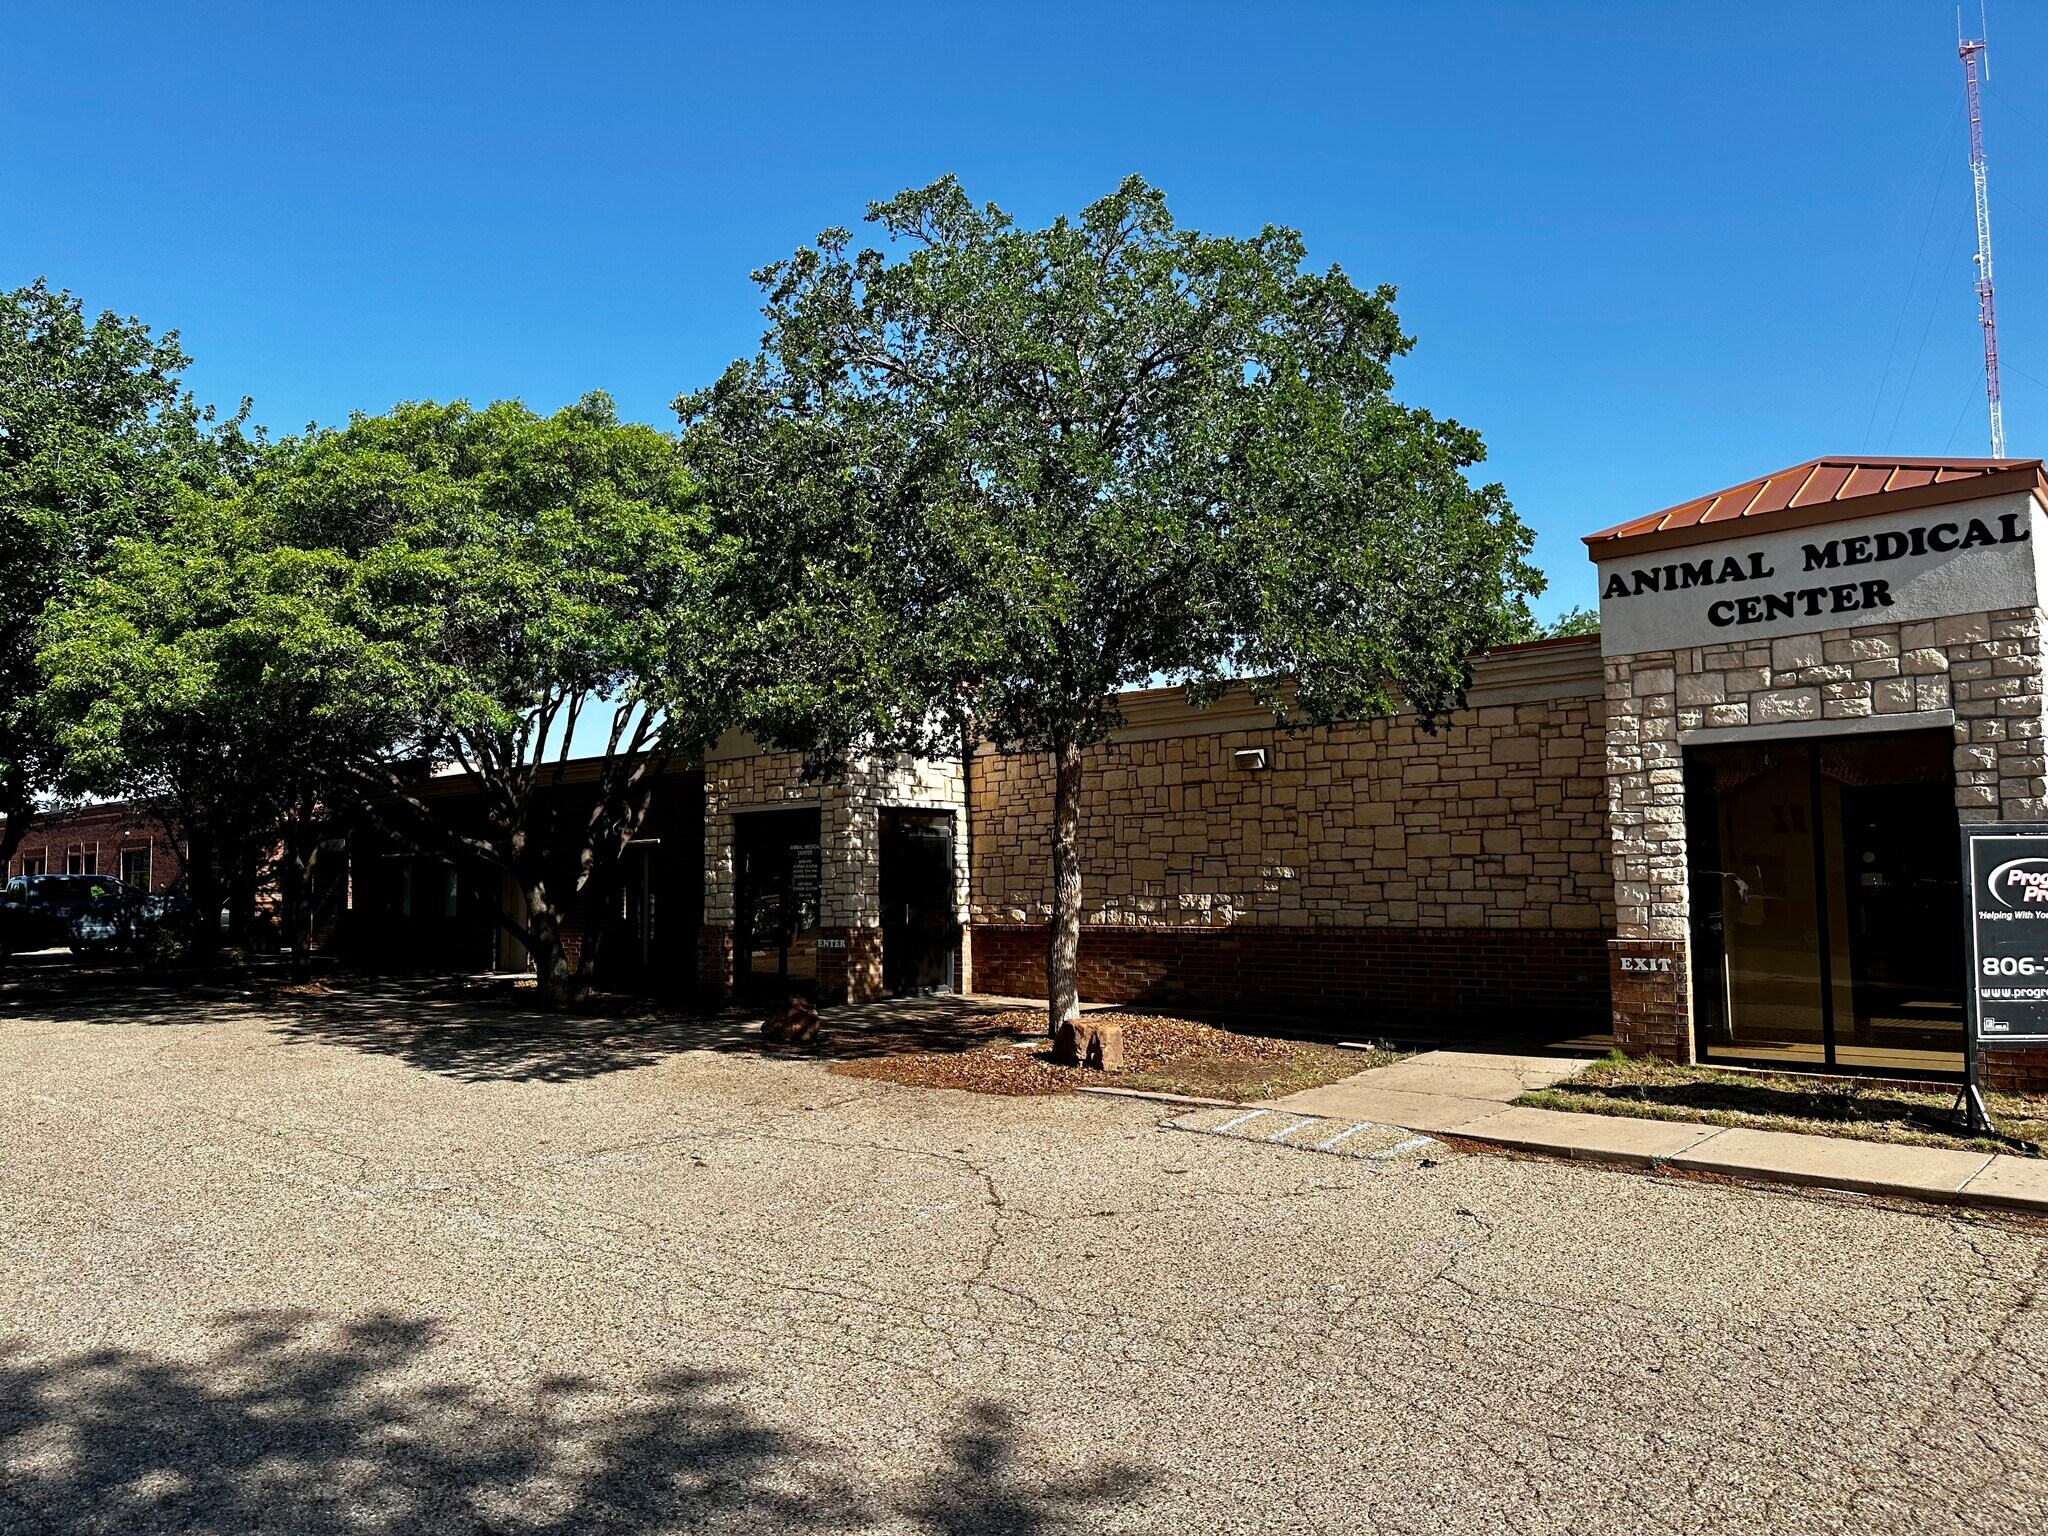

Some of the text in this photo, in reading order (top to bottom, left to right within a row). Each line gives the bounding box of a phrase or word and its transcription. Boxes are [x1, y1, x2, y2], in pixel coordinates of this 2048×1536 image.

[1602, 513, 2030, 600] ANIMAL MEDICAL
[1707, 579, 1895, 627] CENTER
[2015, 910, 2034, 919] With
[817, 939, 846, 948] ENTER
[1620, 957, 1671, 971] EXIT
